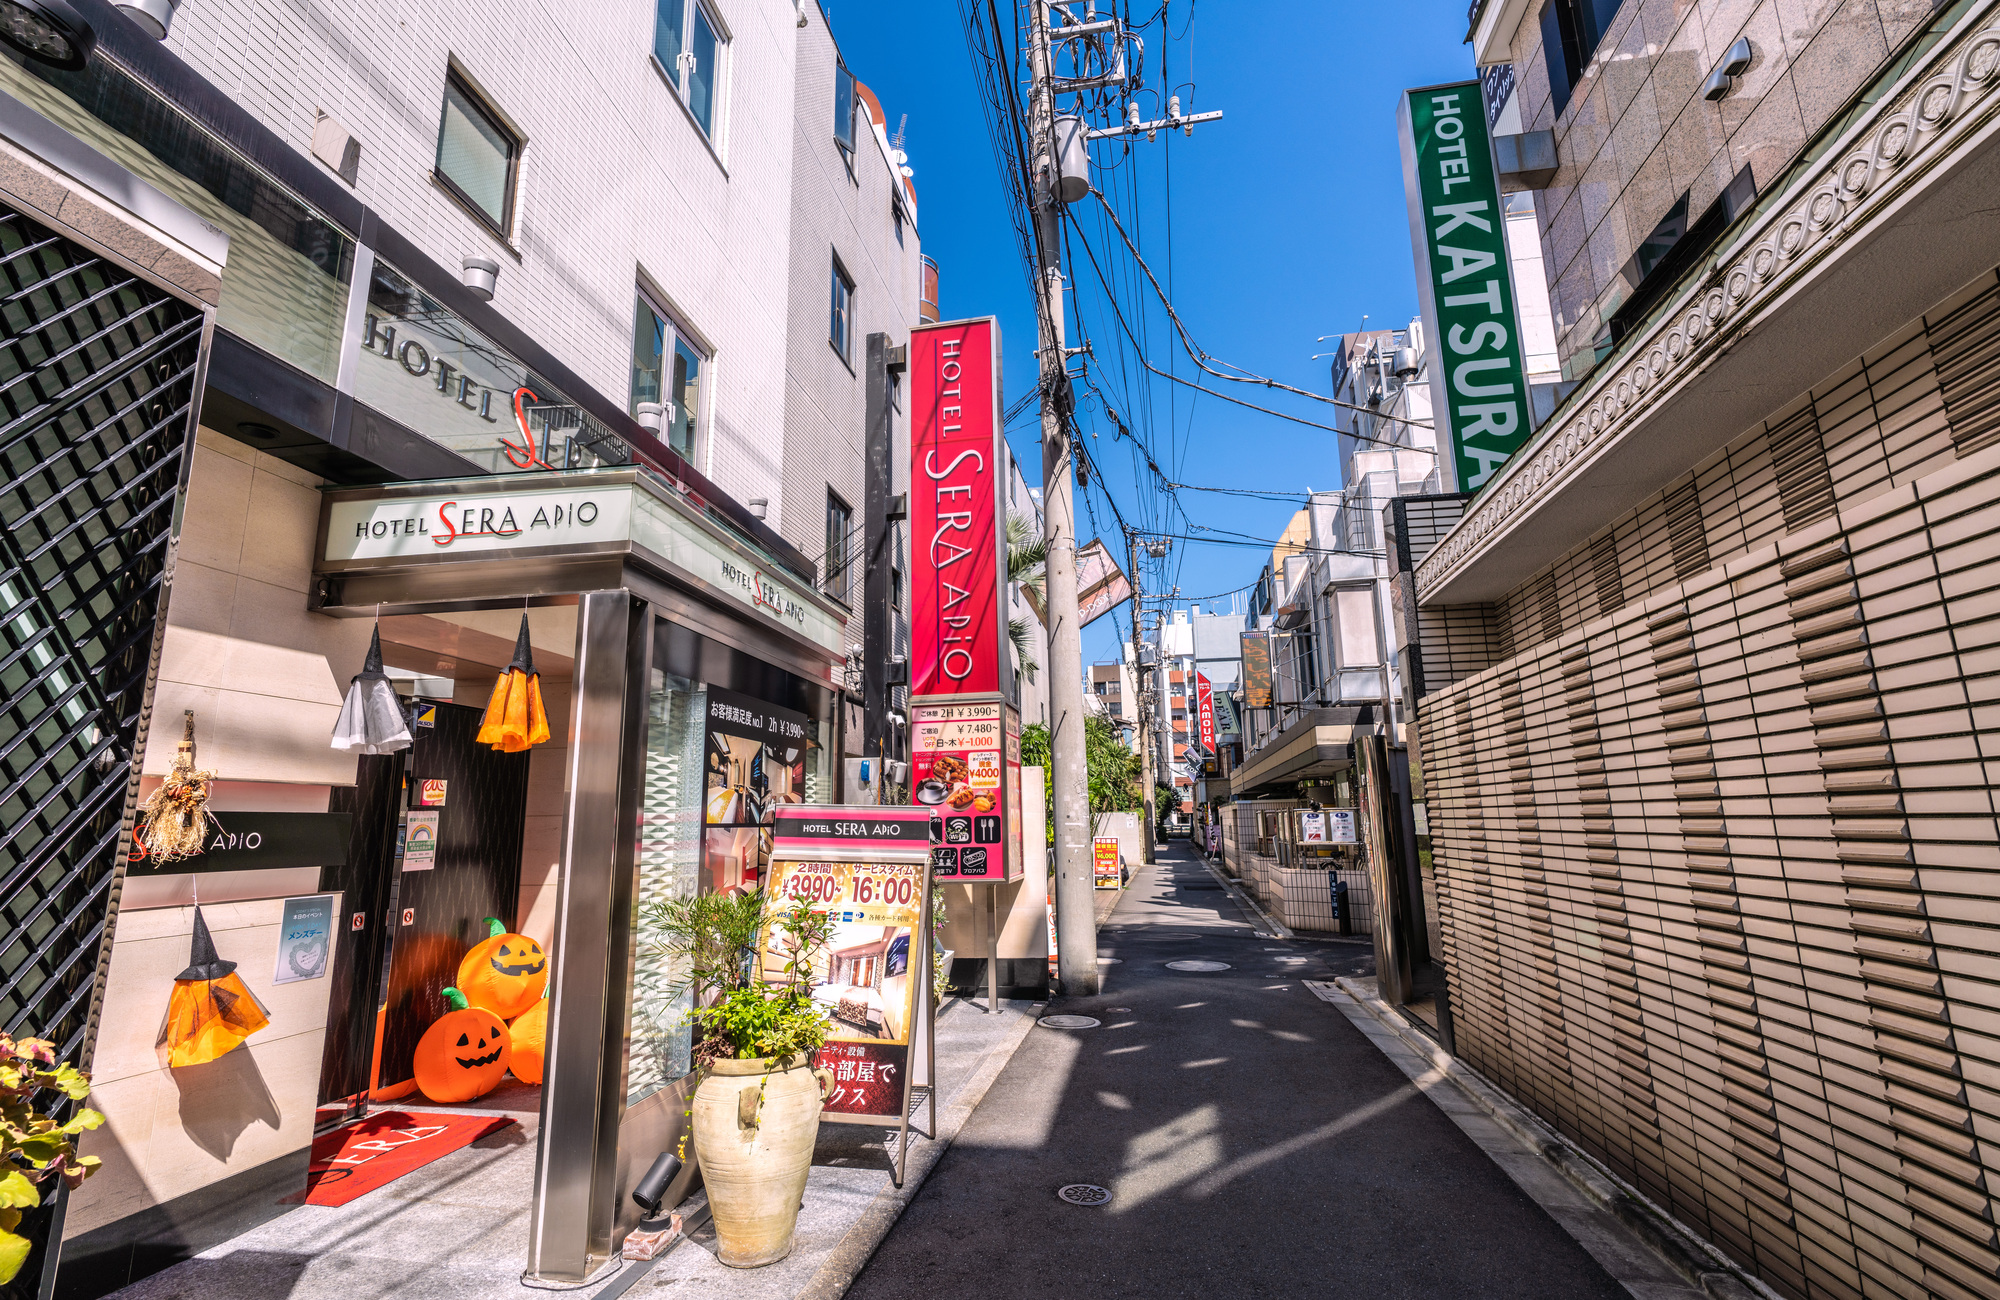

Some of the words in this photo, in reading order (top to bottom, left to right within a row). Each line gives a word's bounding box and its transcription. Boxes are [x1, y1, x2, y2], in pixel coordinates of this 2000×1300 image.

[1432, 94, 1471, 195] HOTEL
[1432, 200, 1519, 490] KATSURA
[363, 313, 497, 424] HOTEL
[498, 387, 600, 475] SER
[942, 339, 962, 438] HOTEL
[355, 517, 428, 538] HOTEL
[431, 501, 522, 545] SERA
[925, 449, 983, 570] SERA
[721, 560, 752, 590] HOTEL
[752, 571, 783, 614] SERA
[710, 701, 752, 727] お客様満足度
[768, 716, 778, 733] 2h
[940, 708, 954, 718] 2H
[1213, 697, 1232, 731] PEAR
[1185, 764, 1199, 776] FOX
[803, 824, 832, 834] HOTEL
[834, 822, 868, 836] SERA
[797, 863, 832, 874] 2時間
[854, 863, 914, 876] サービスタイム
[852, 876, 912, 905] 16:00
[293, 912, 322, 920] 本日のイベント
[288, 929, 323, 940] メンズデー
